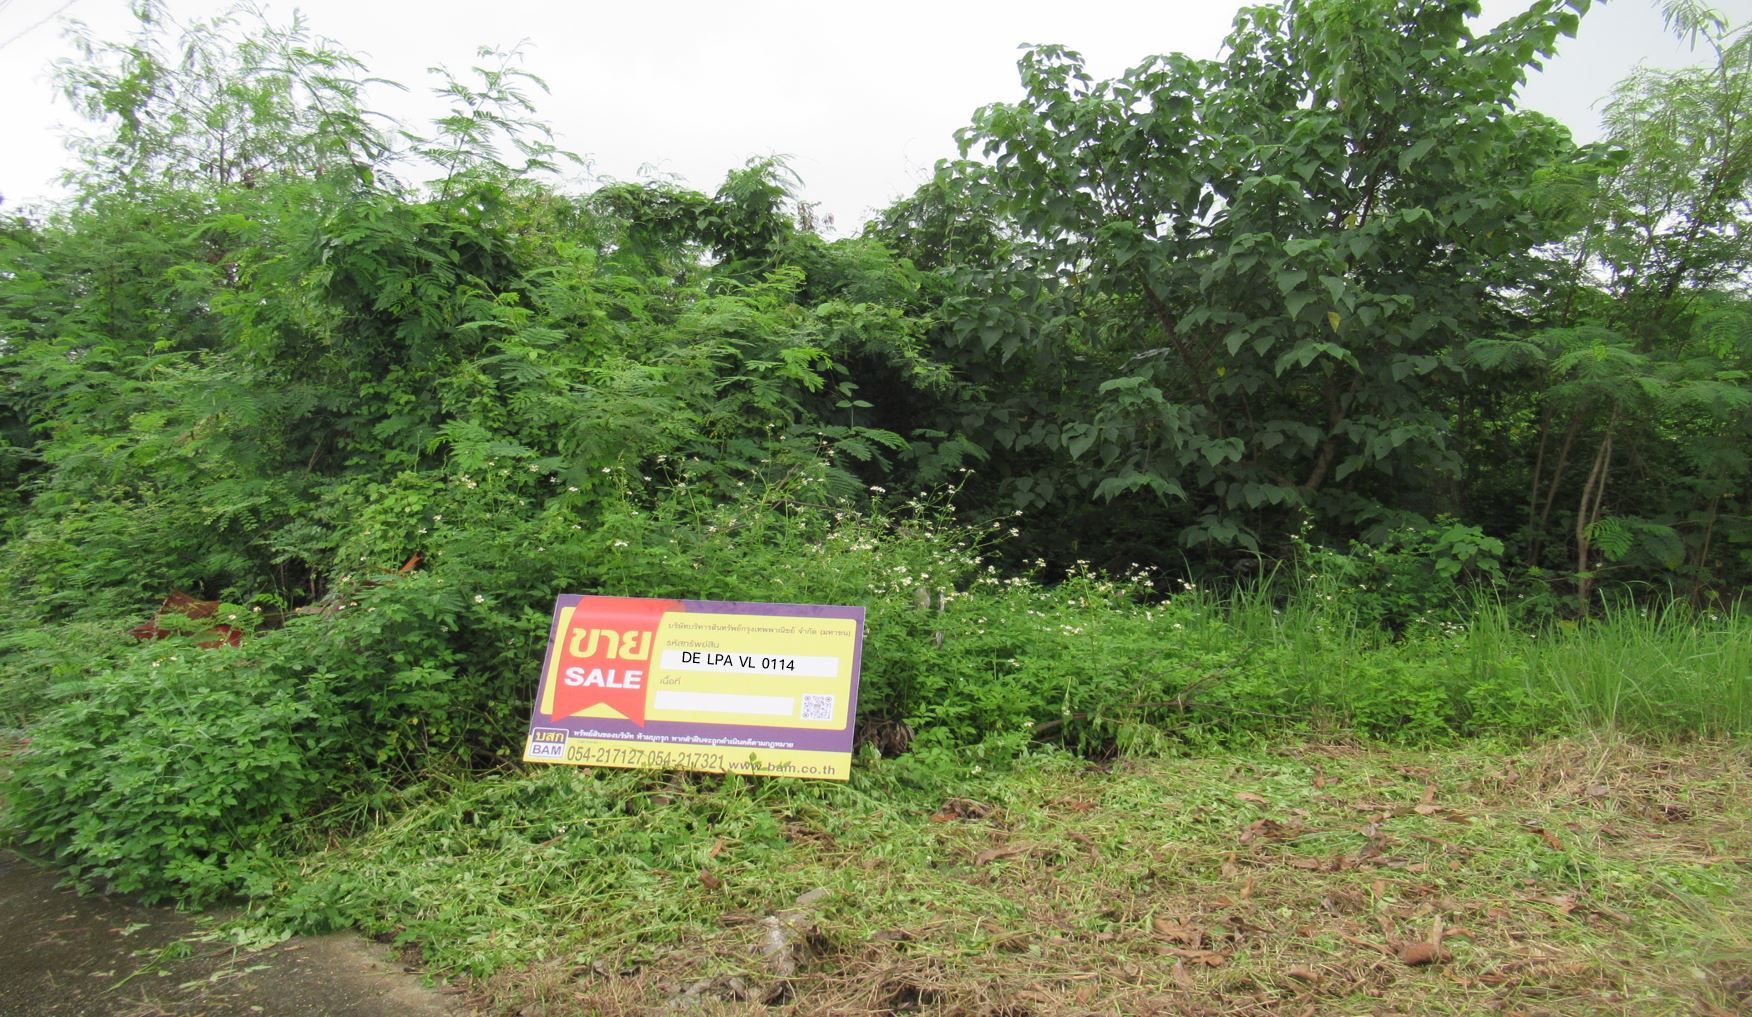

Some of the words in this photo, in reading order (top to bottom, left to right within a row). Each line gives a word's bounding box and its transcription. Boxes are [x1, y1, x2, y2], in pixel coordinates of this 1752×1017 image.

[568, 627, 652, 661] ขาย
[564, 667, 645, 690] SALE
[535, 731, 564, 743] บสก
[532, 744, 562, 755] BAM
[728, 761, 836, 775] wwwbam.co.th
